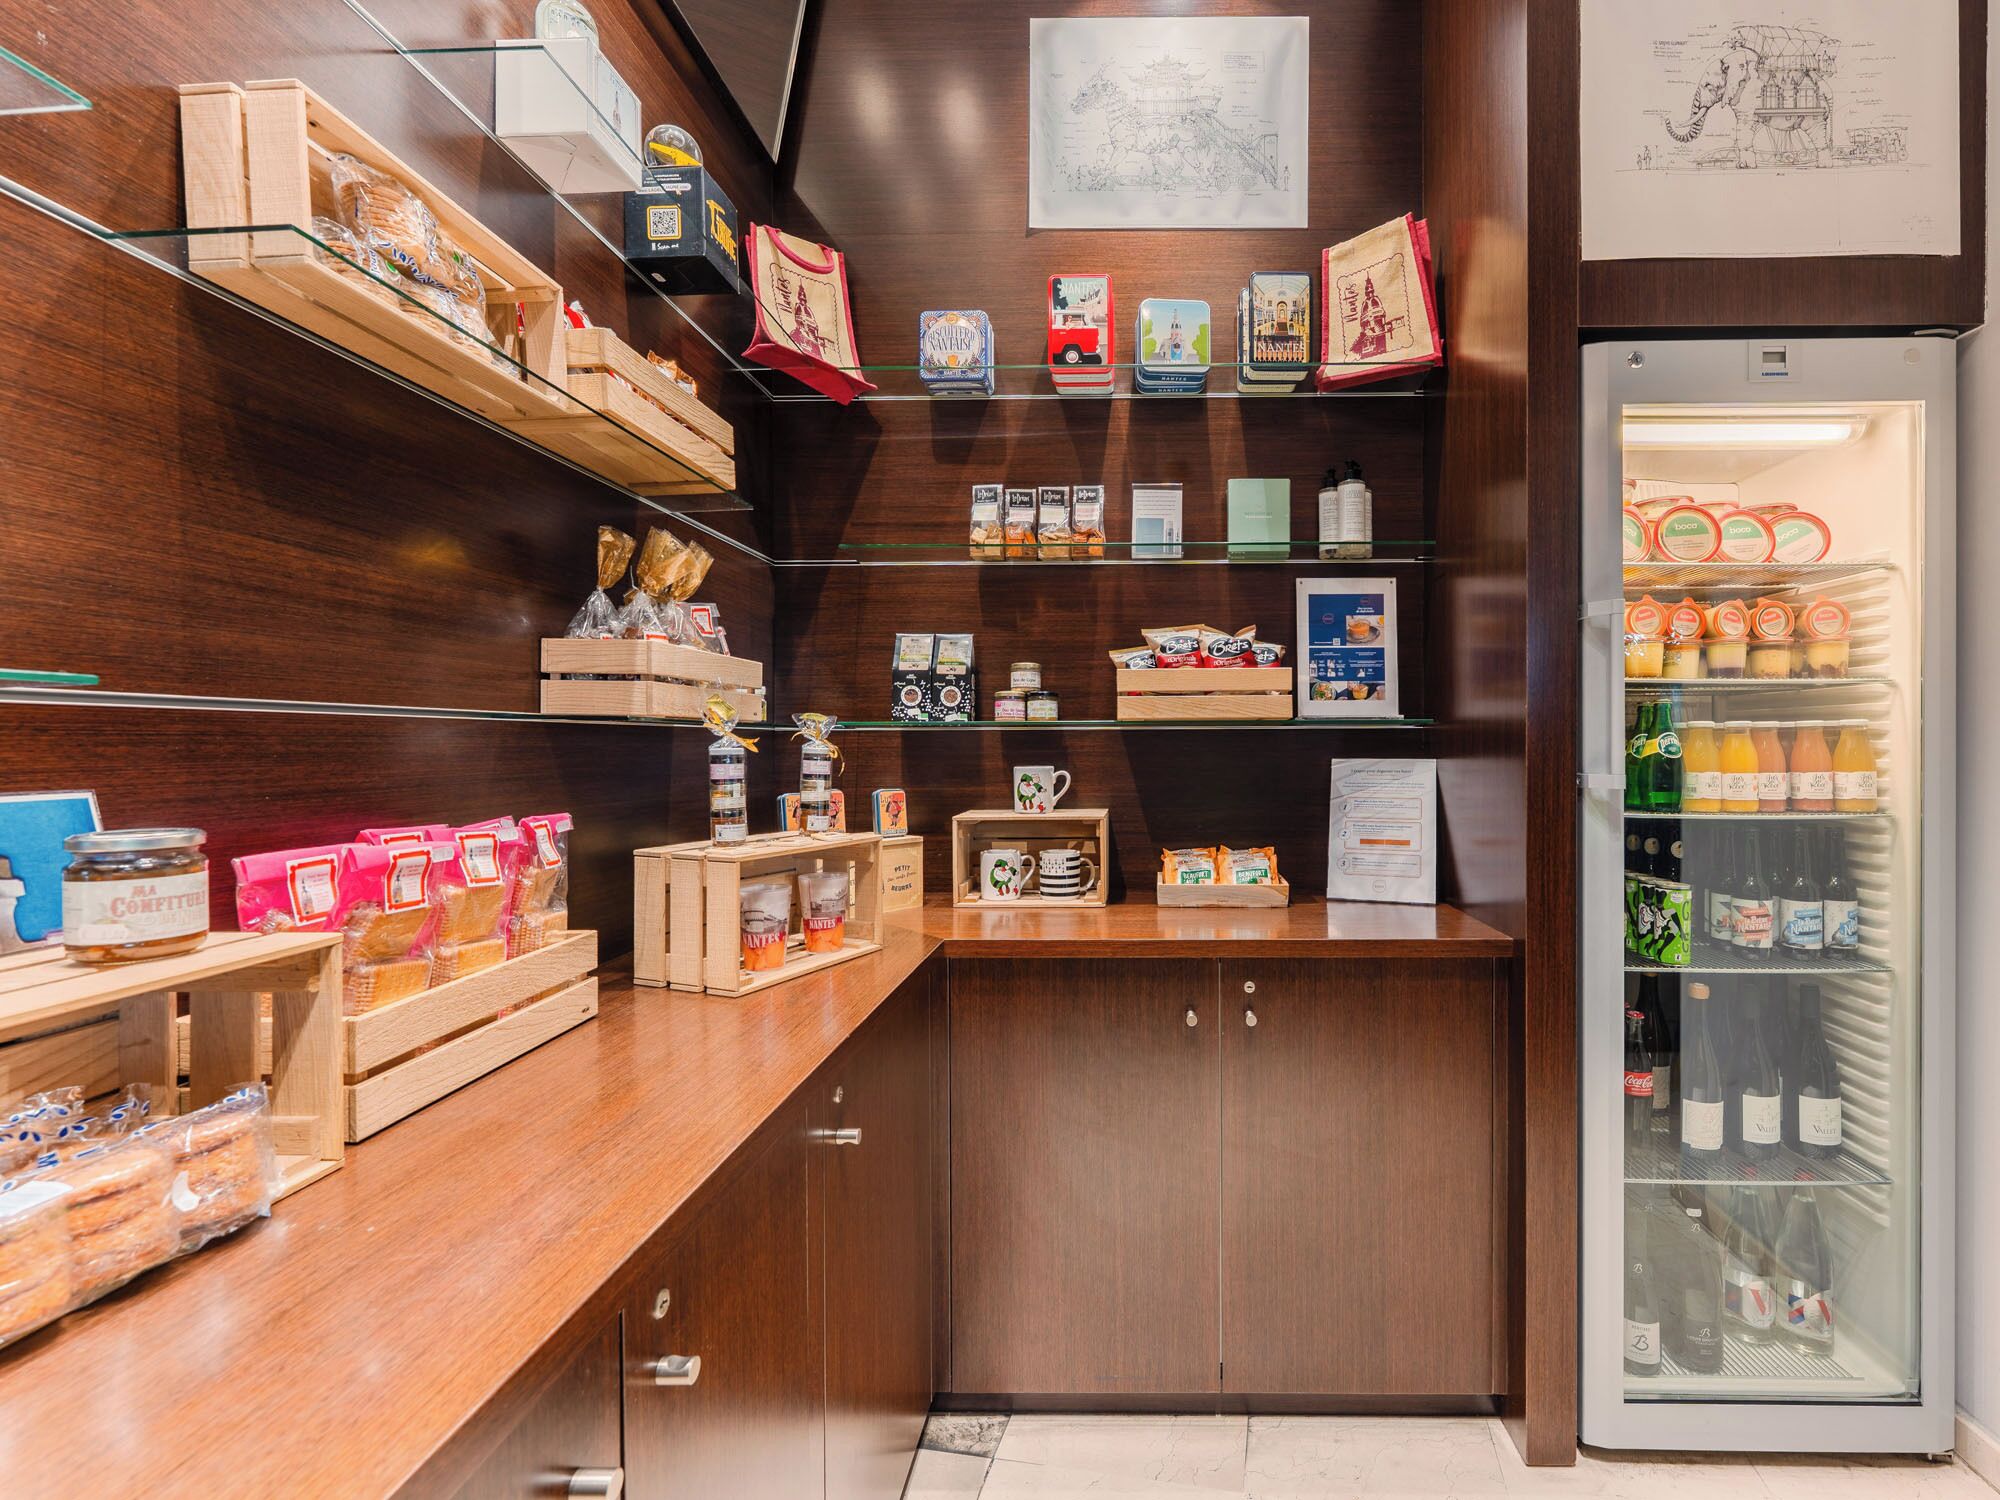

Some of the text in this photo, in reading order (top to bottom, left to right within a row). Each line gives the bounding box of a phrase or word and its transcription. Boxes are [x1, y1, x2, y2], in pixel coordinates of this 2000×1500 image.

[1257, 342, 1305, 352] NANTES
[894, 864, 911, 873] PETIT
[891, 882, 913, 892] BEURRE
[808, 919, 836, 930] NANTES
